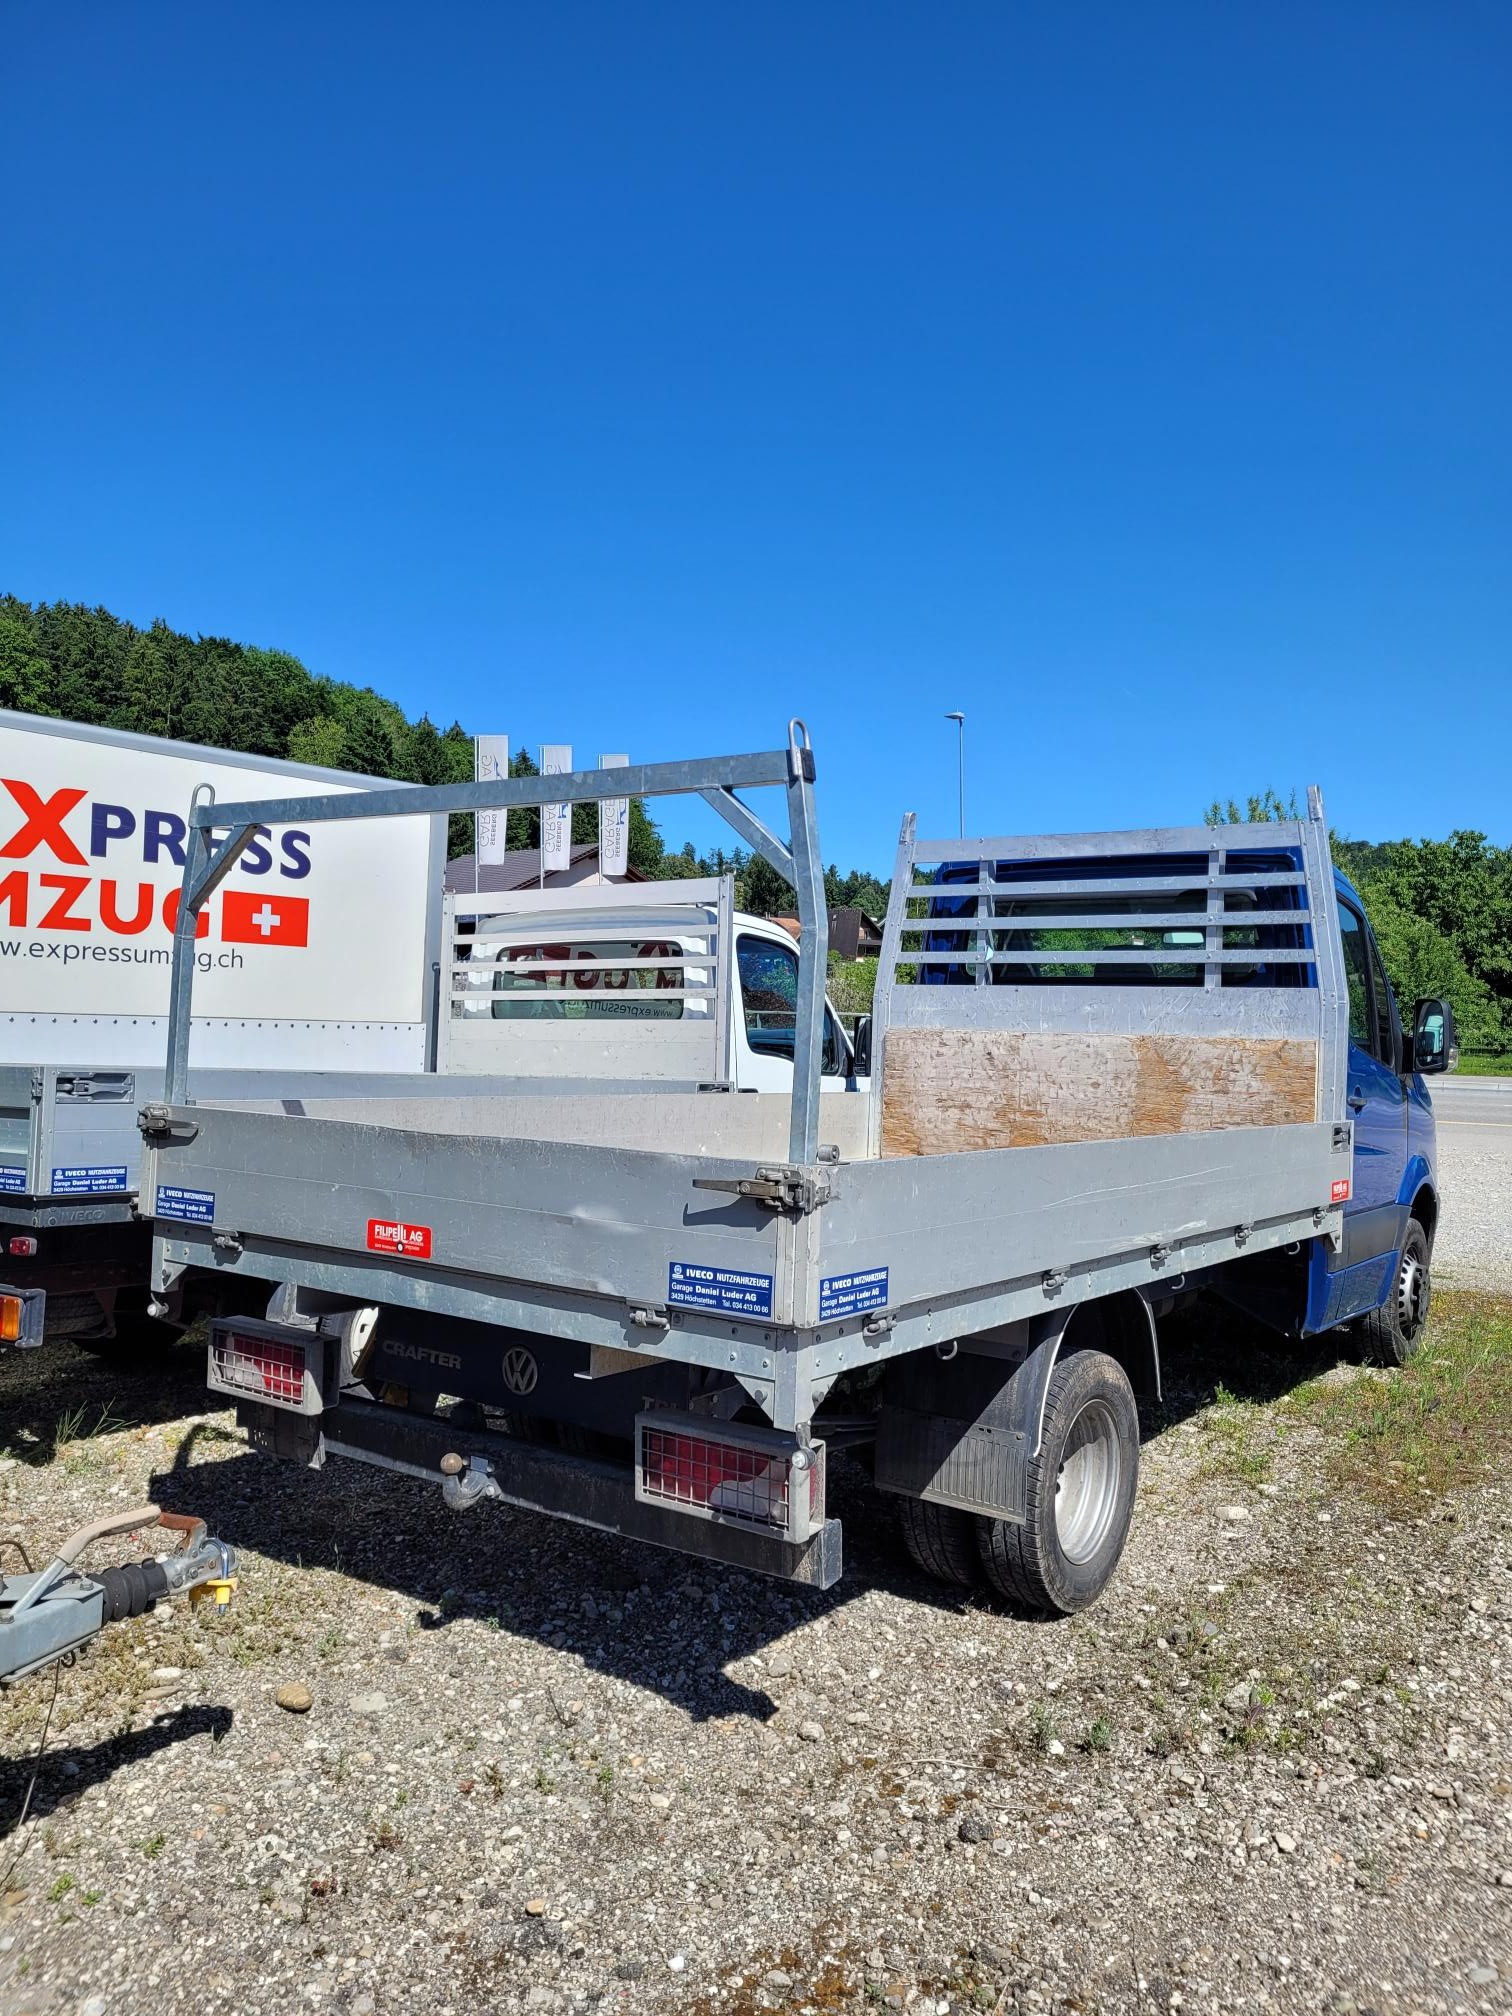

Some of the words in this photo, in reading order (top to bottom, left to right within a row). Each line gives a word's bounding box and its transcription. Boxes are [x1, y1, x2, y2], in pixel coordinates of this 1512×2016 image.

[0, 778, 312, 880] XPRSS
[166, 1189, 182, 1198] IVECO
[410, 1231, 423, 1242] AG
[686, 1268, 714, 1280] IVECO
[716, 1273, 770, 1288] NUTZFAHRZEUGE
[832, 1278, 852, 1290] IVECO
[670, 1292, 684, 1301] 3429
[684, 1293, 717, 1306] Höchstetten
[722, 1299, 732, 1308] Tel.
[743, 1303, 753, 1311] 413
[671, 1282, 694, 1292] Garage
[695, 1285, 720, 1296] Daniel
[722, 1289, 743, 1299] Luder
[744, 1292, 757, 1302] AG
[821, 1298, 838, 1308] Garage
[838, 1293, 856, 1304] Daniel
[856, 1291, 871, 1300] Luder
[871, 1287, 880, 1296] AG
[382, 1340, 462, 1370] CRAFTER
